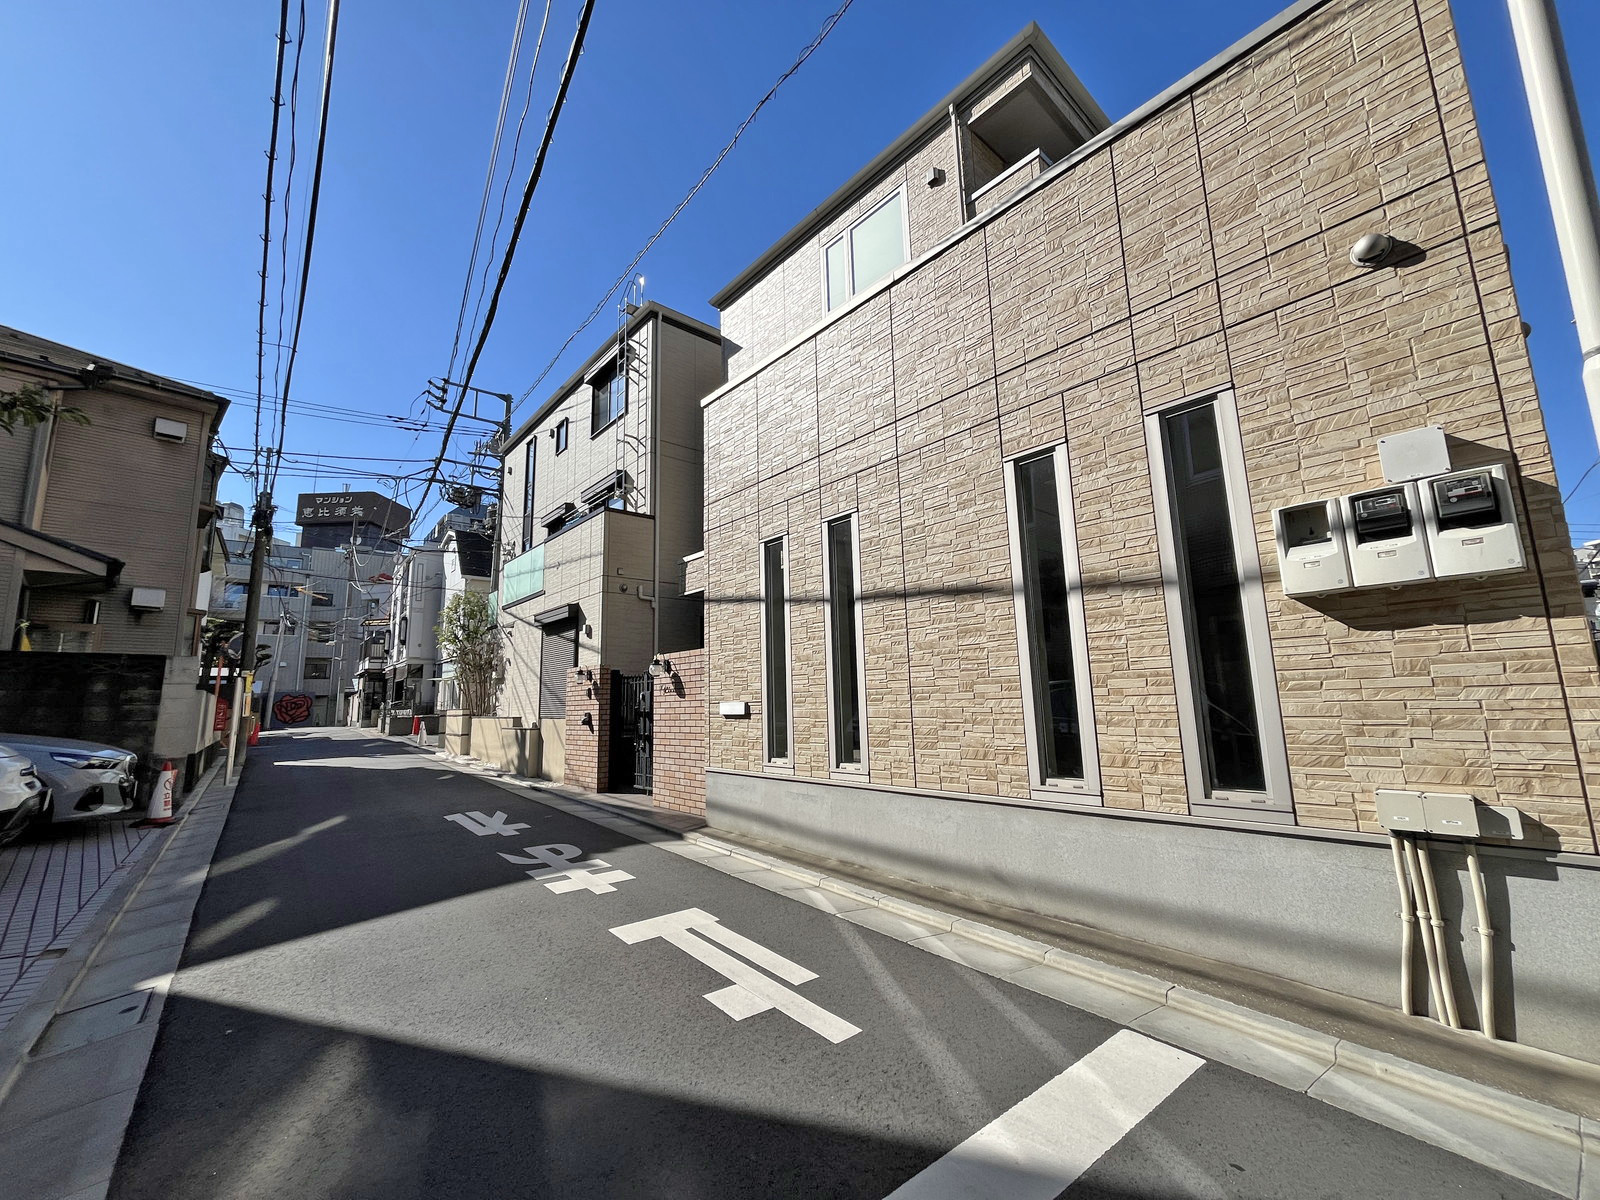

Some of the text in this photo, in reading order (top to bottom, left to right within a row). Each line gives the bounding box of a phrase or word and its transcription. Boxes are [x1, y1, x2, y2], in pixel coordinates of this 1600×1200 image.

[315, 496, 353, 504] マンション
[443, 810, 863, 1044] 止まれ
